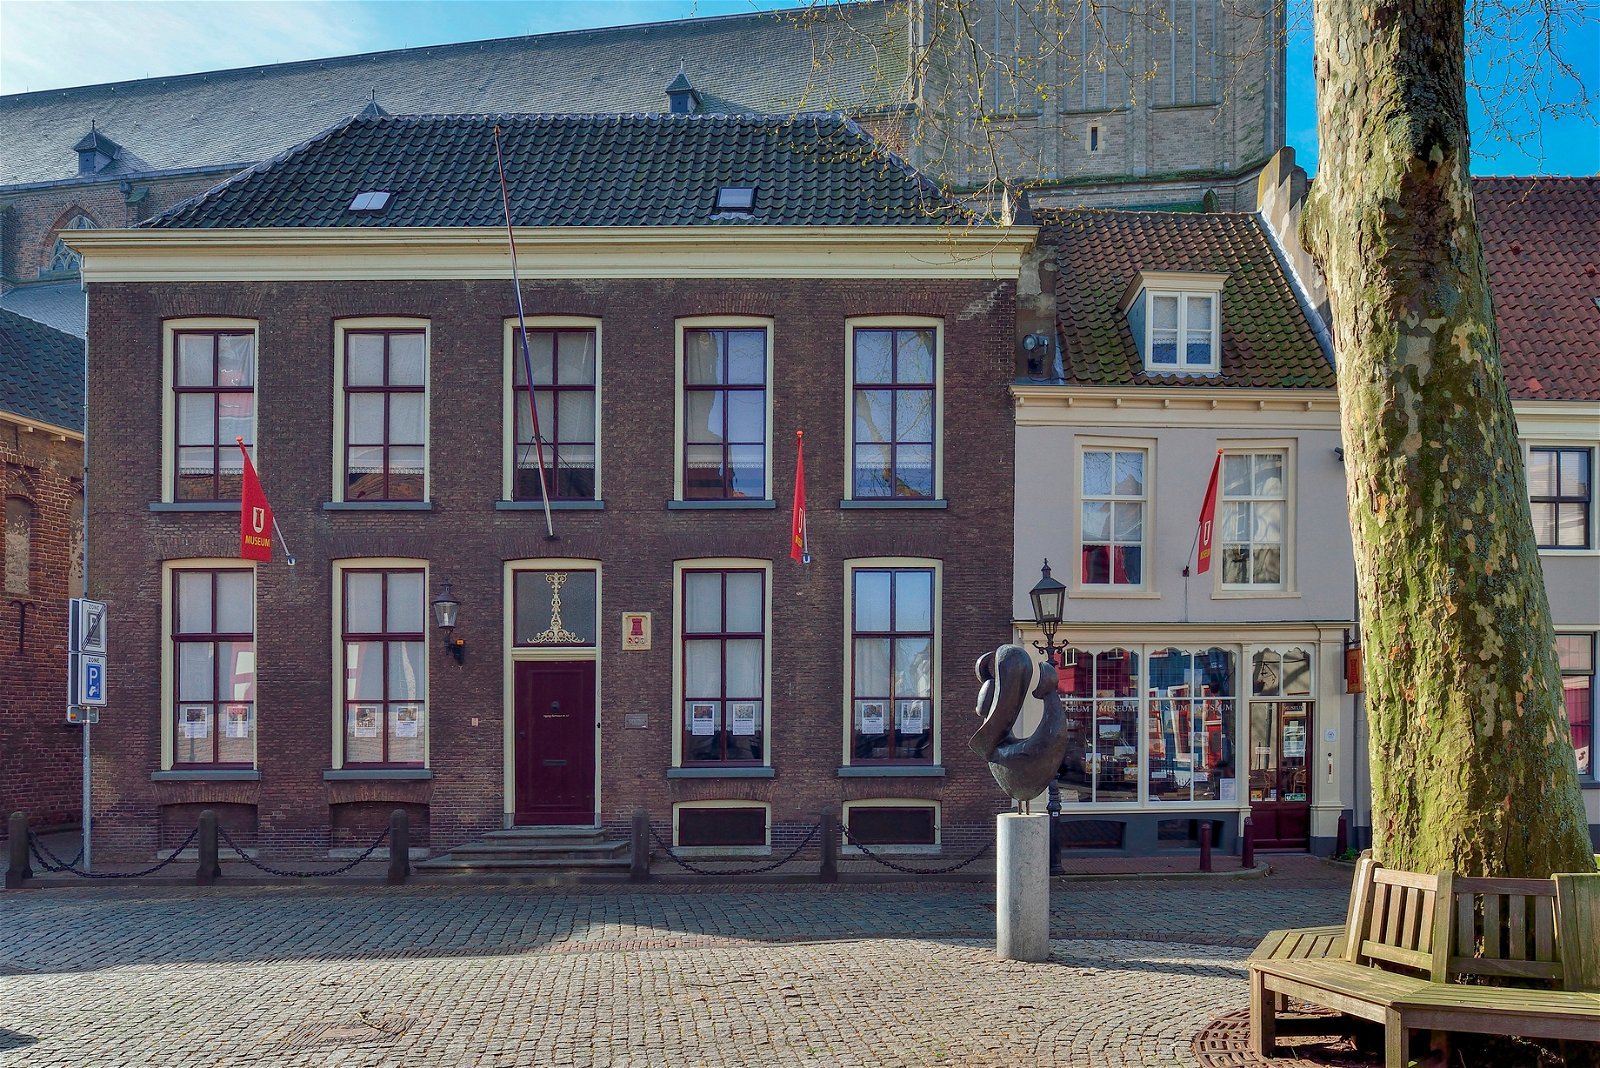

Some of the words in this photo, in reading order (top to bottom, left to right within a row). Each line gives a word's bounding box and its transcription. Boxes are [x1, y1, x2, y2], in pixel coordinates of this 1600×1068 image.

[244, 534, 272, 547] MUSEUM
[88, 603, 100, 611] ZONE
[89, 667, 98, 685] P
